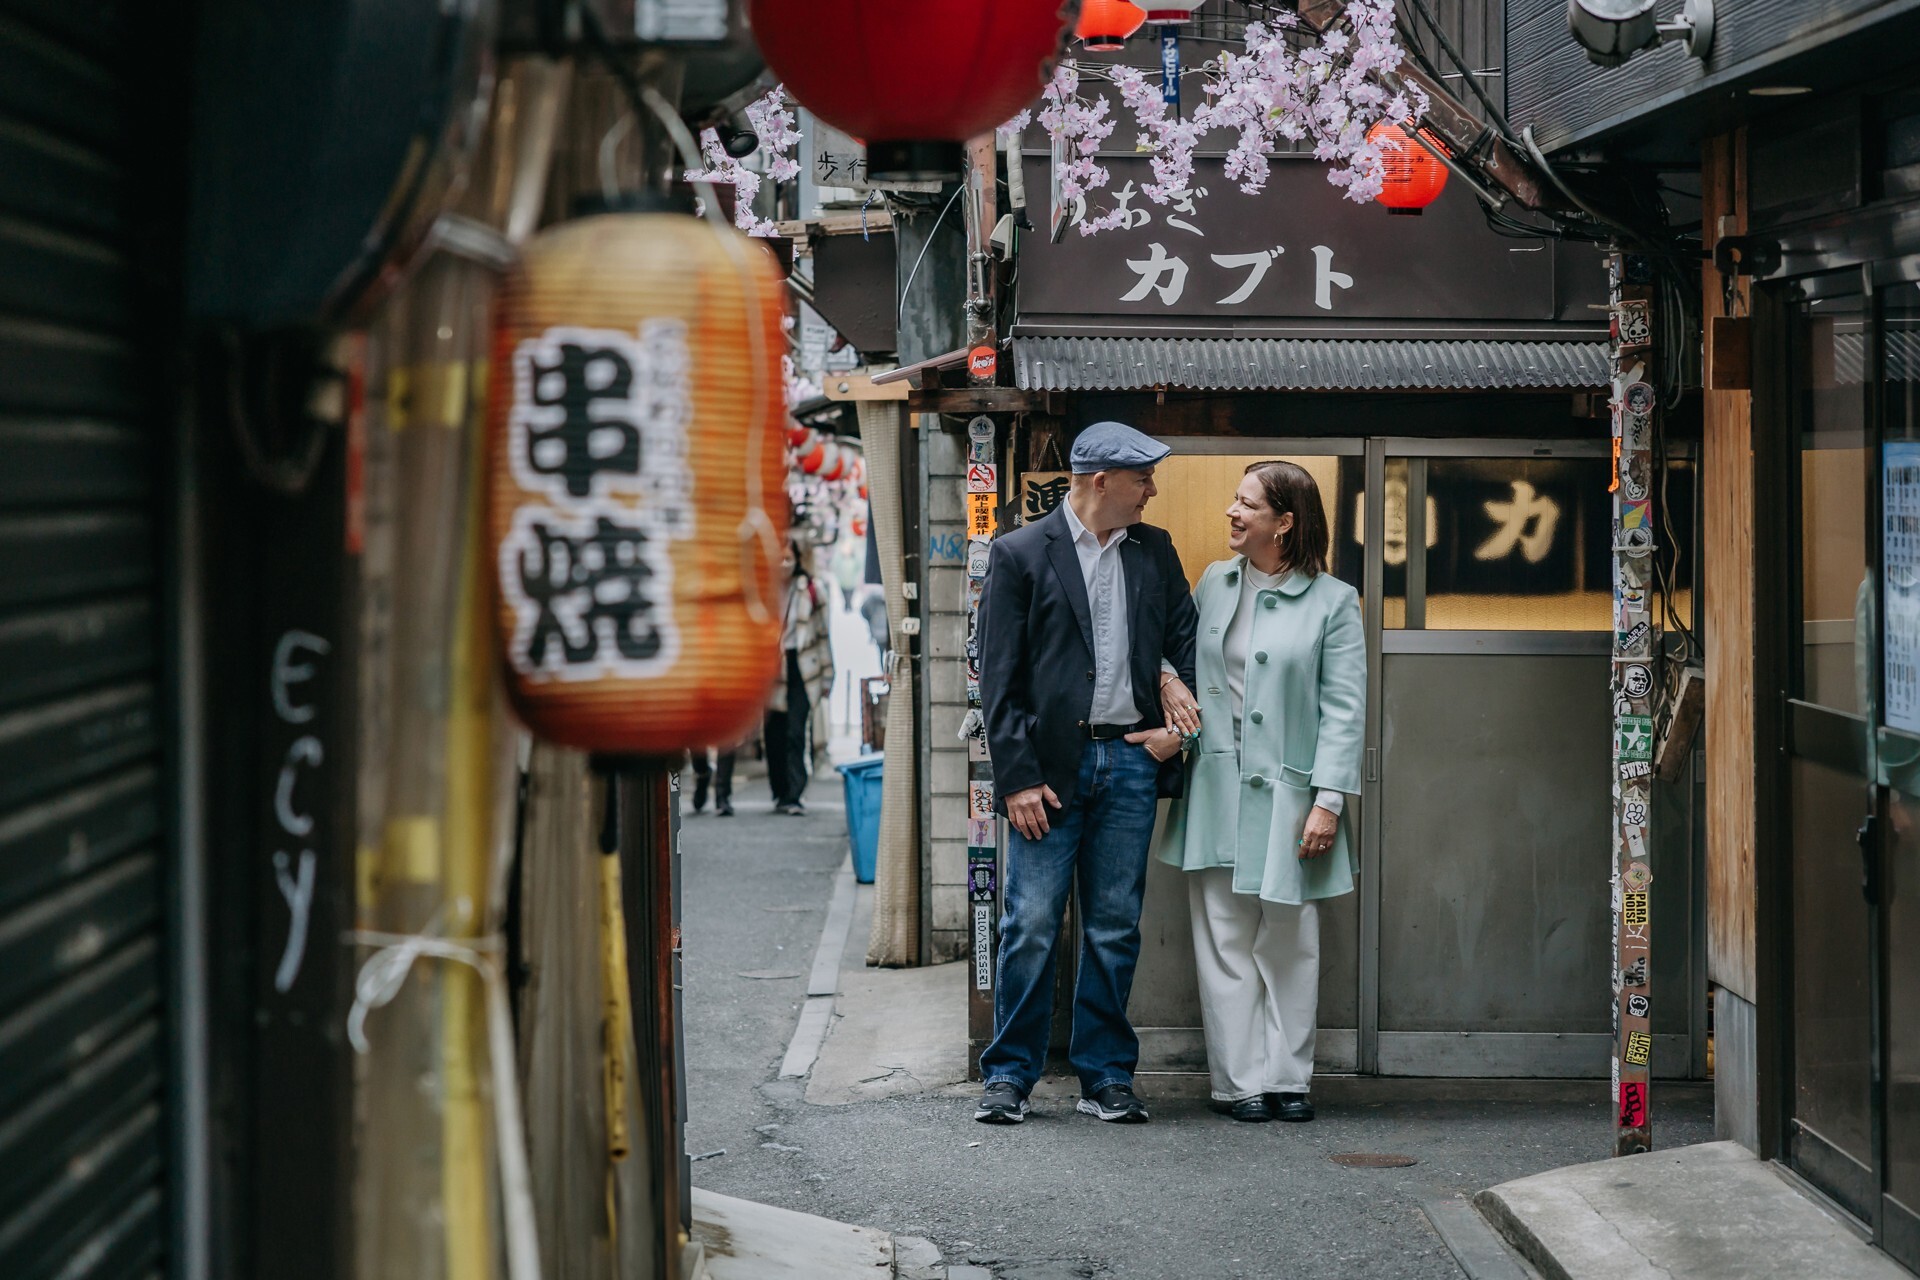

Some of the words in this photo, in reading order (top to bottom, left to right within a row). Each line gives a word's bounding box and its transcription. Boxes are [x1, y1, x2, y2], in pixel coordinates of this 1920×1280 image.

[1118, 242, 1354, 310] カブト
[974, 494, 990, 535] 路上喫煙禁止
[1625, 893, 1636, 925] NOISE
[1636, 893, 1647, 924] PARA
[1634, 1034, 1651, 1059] LUCE
